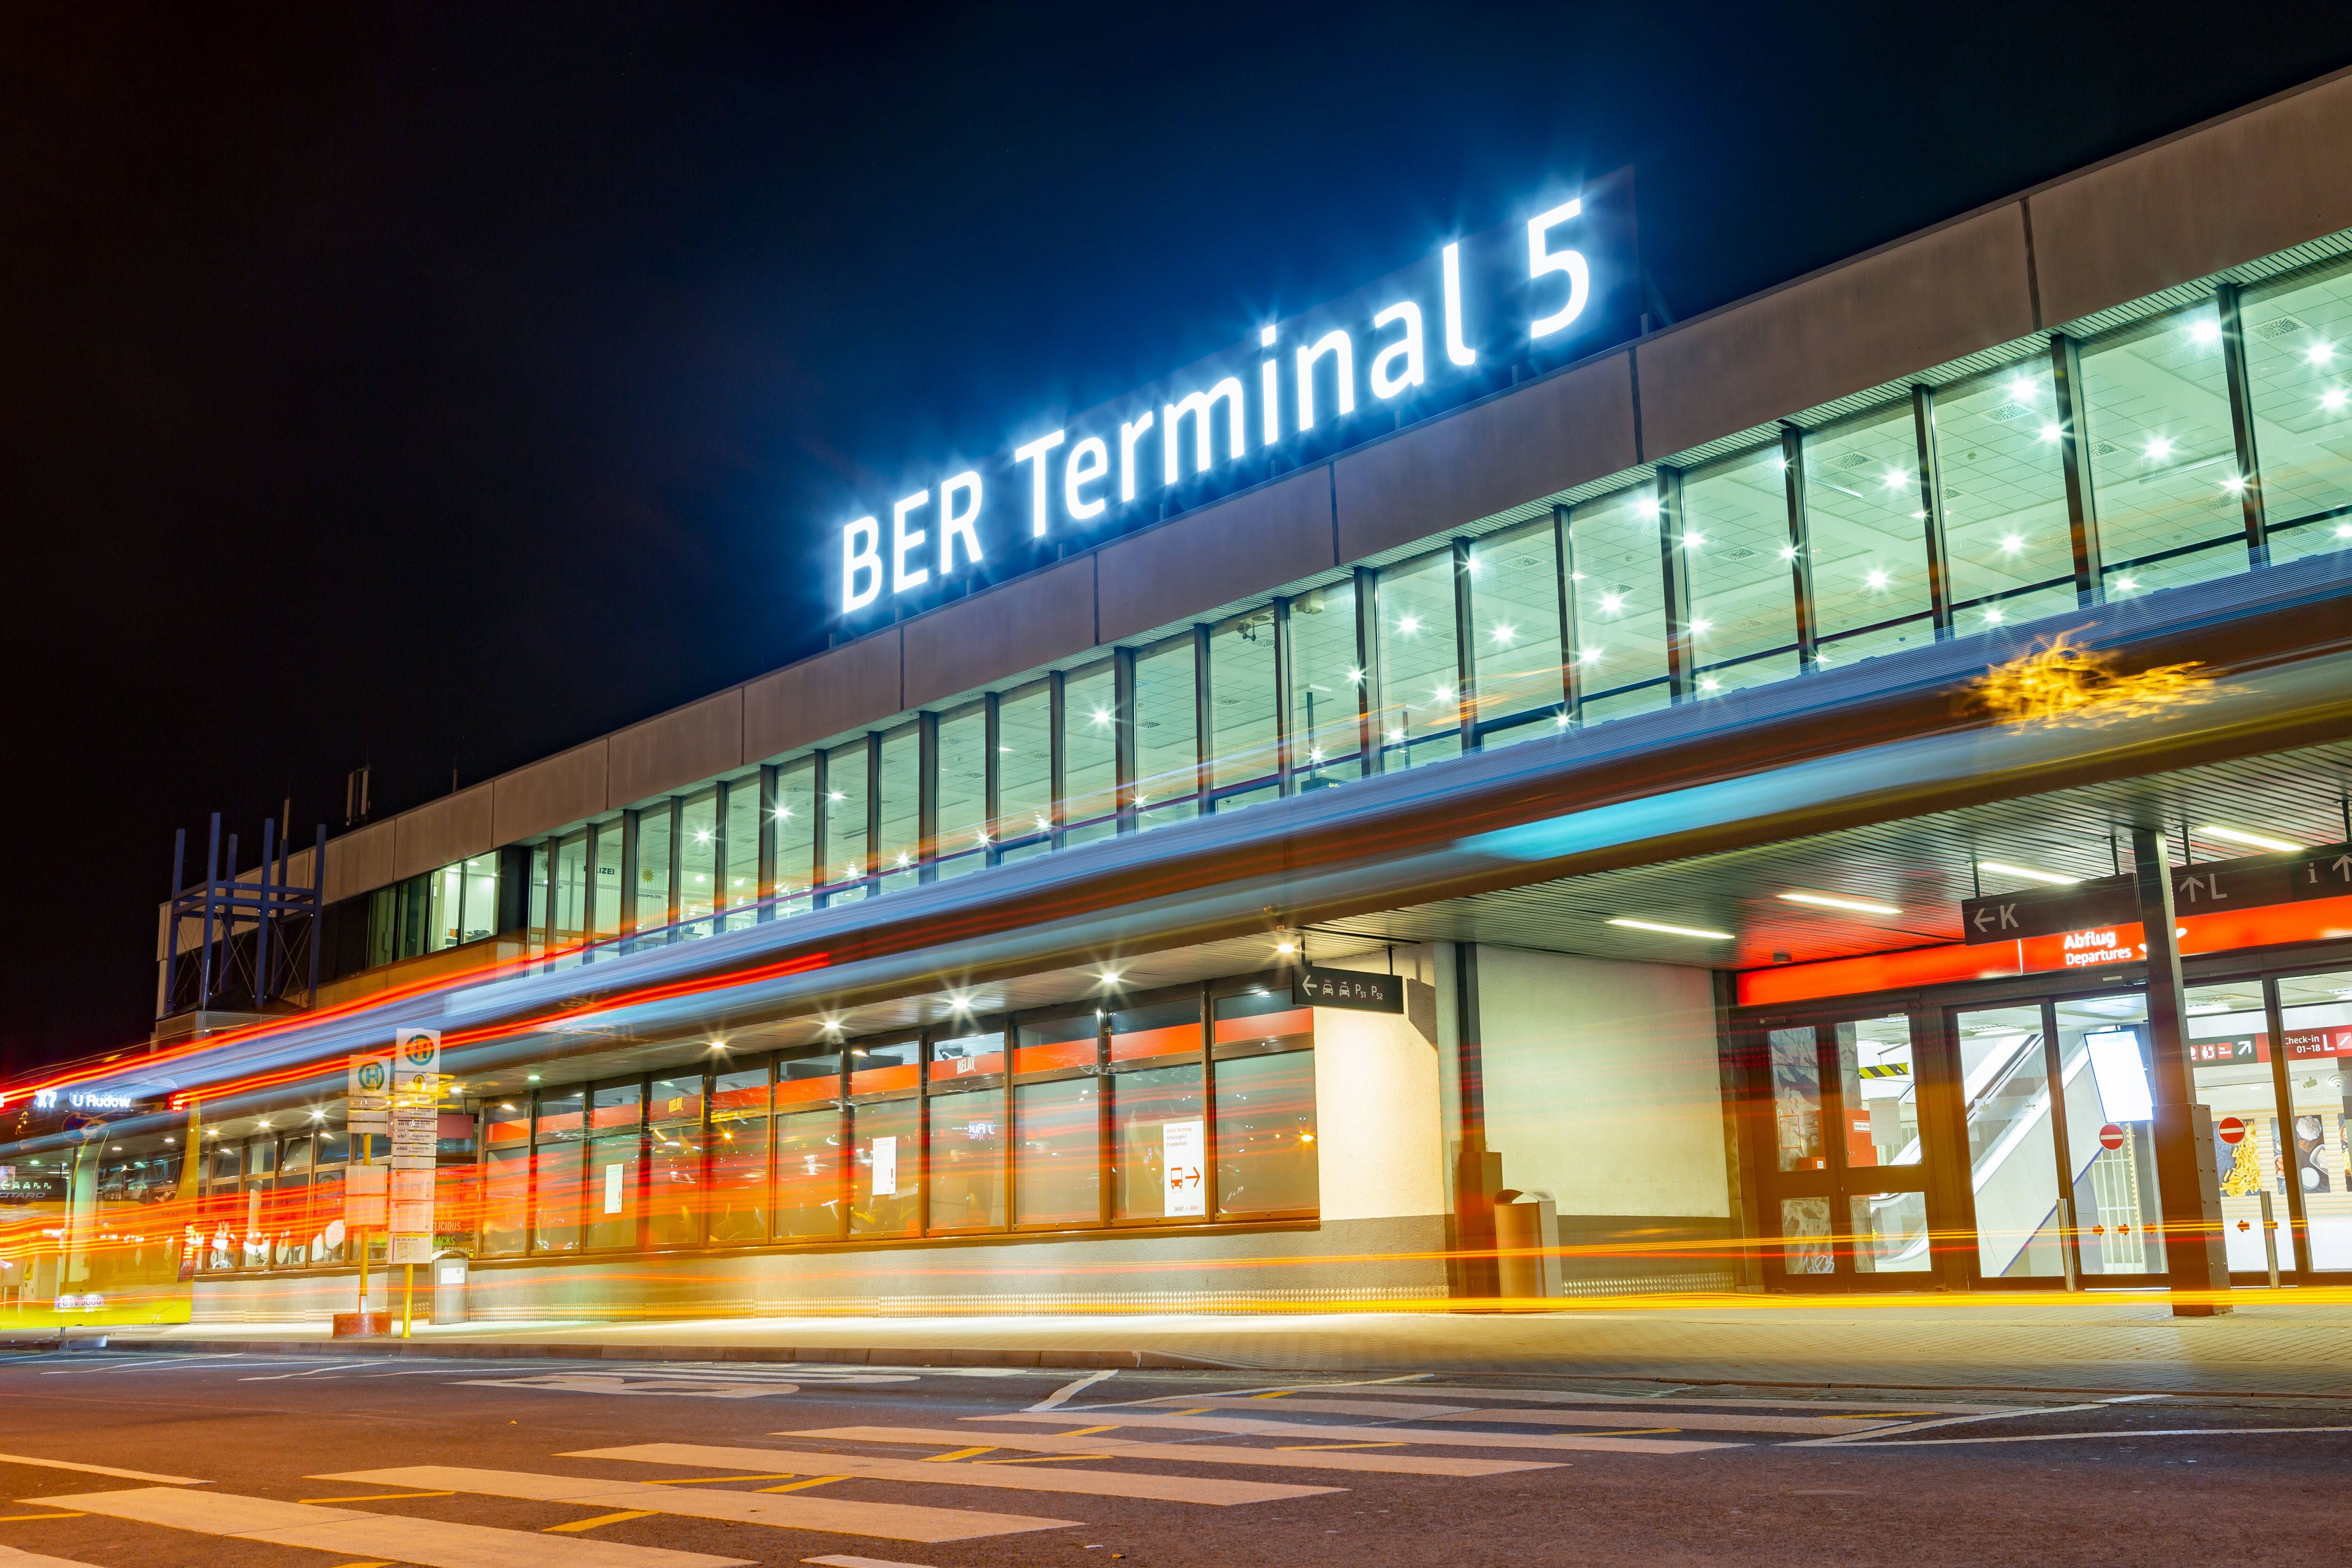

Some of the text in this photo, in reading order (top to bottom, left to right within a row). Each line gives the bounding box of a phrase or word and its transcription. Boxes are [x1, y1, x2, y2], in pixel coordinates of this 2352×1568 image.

[841, 198, 1590, 614] BER Terminal 5
[2209, 874, 2227, 899] L
[2000, 903, 2020, 930] K
[2064, 931, 2116, 950] Abflug
[2066, 947, 2132, 966] Departures
[2322, 1034, 2336, 1051] L
[34, 1090, 131, 1108] X7 U Rudow
[432, 1221, 461, 1231] LICIOUS
[432, 1236, 456, 1246] NACKS
